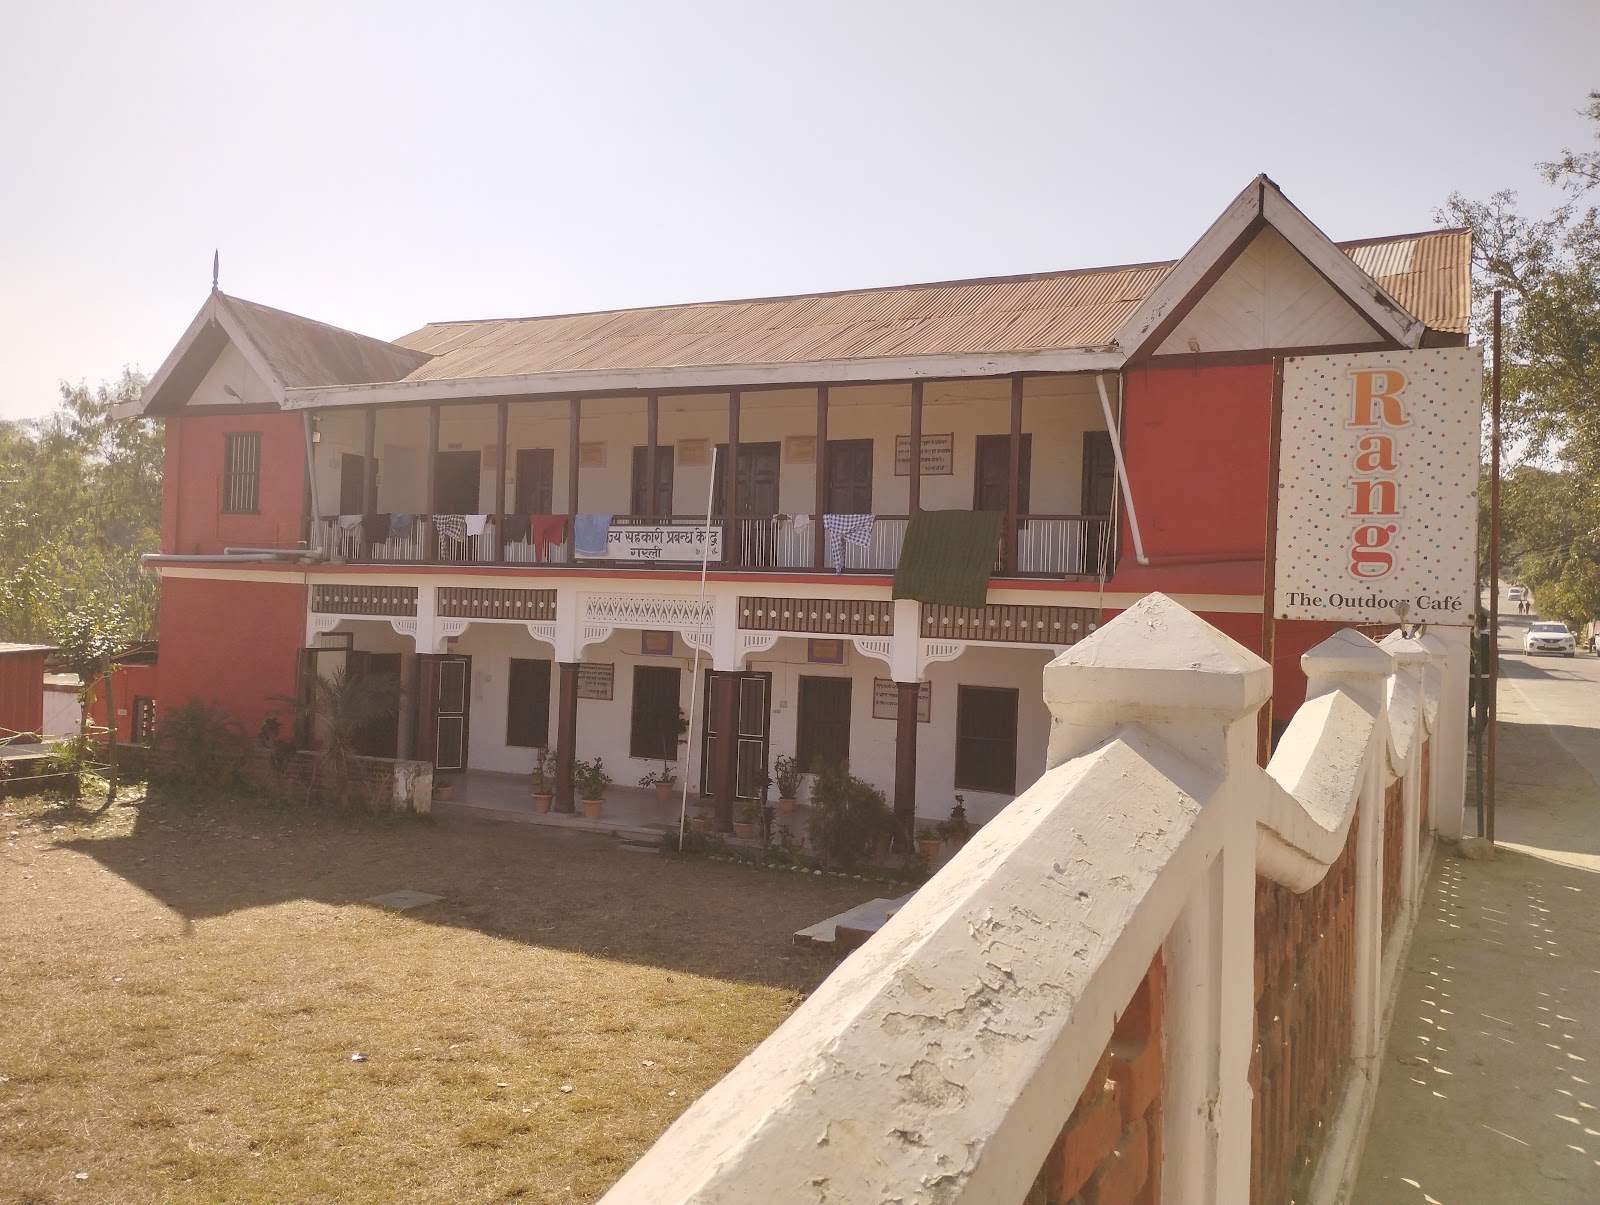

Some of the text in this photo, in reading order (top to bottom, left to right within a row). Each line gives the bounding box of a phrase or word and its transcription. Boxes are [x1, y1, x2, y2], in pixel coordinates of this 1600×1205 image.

[1346, 369, 1412, 578] Rang
[625, 528, 664, 545] सहकारी
[666, 530, 694, 545] प्रबन्ध
[1286, 592, 1462, 610] The Outdoo Café
